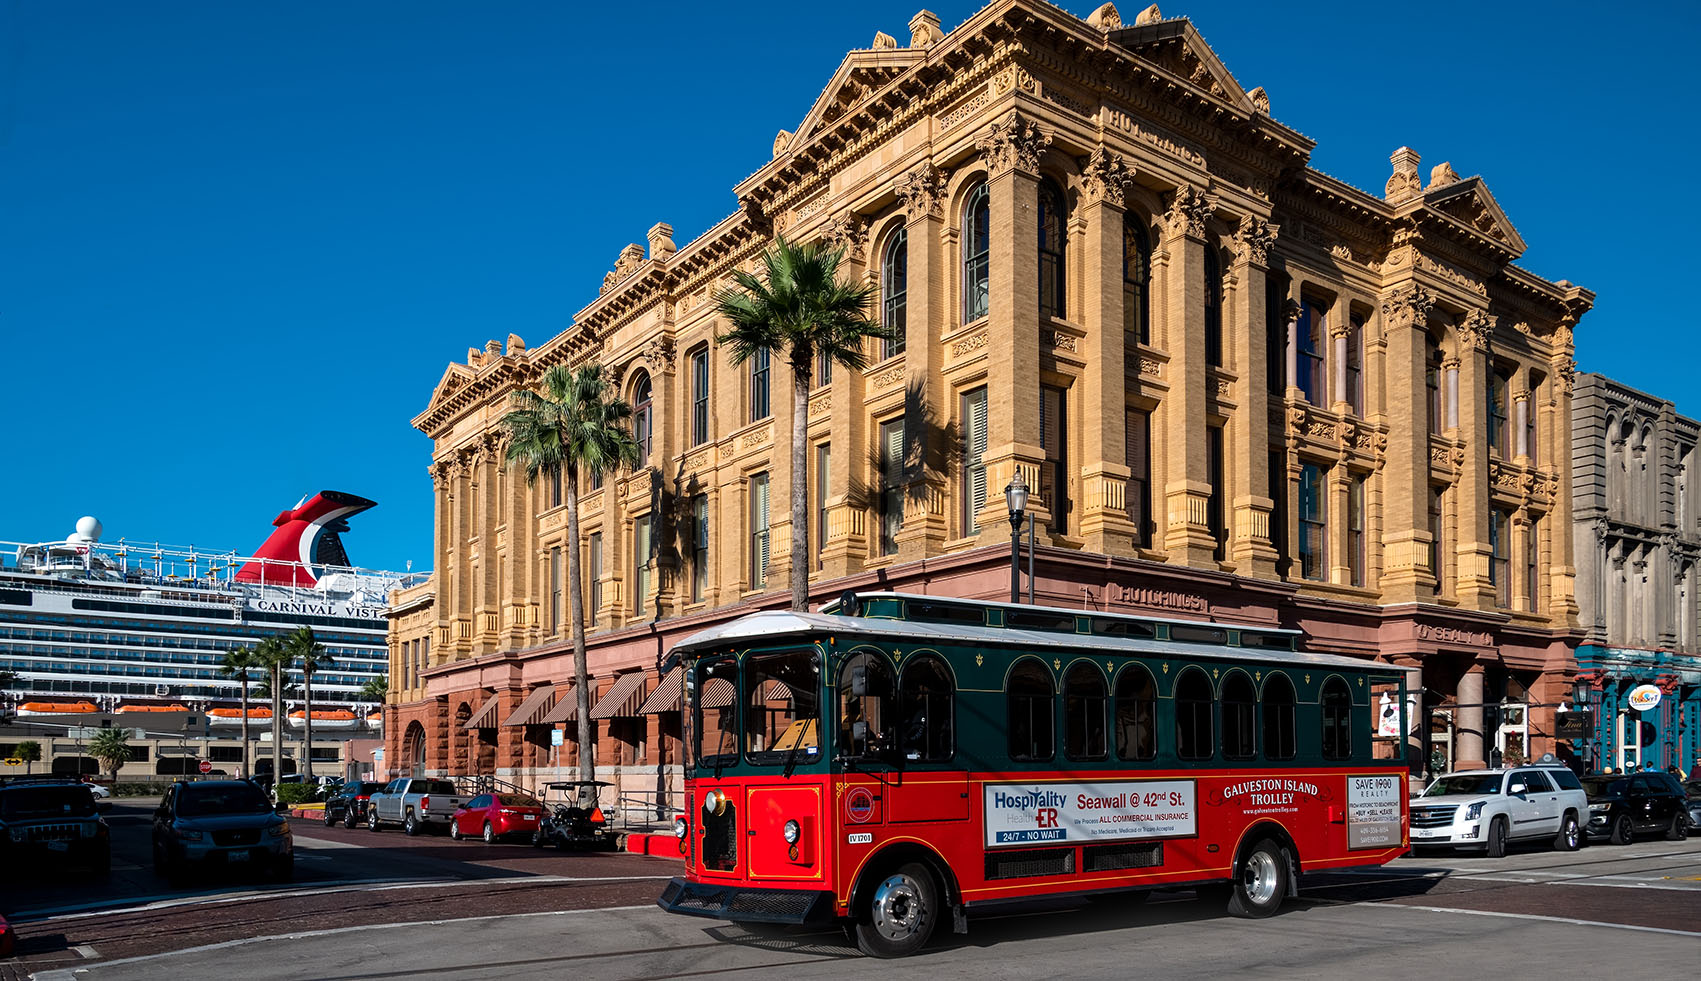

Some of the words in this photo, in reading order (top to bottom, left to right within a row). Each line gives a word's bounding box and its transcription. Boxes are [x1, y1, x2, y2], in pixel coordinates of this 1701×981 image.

[1119, 586, 1201, 609] HUTCHINGS
[257, 600, 337, 616] CARNIVAL
[346, 607, 384, 619] VIST
[1435, 626, 1473, 643] SEALY
[1223, 779, 1282, 799] GALVESTON
[1284, 779, 1318, 796] ISLAND
[1355, 779, 1373, 789] SAVE
[995, 790, 1067, 811] Hospitality
[1077, 793, 1127, 809] Seawall
[1130, 792, 1140, 808] @
[1143, 792, 1167, 807] 42nd
[1169, 791, 1185, 807] St.
[1250, 793, 1294, 805] TROLLEY
[1360, 790, 1389, 798] REALTY
[1006, 812, 1034, 824] Health
[1035, 808, 1059, 828] ER
[1099, 816, 1112, 824] ALL
[1112, 814, 1154, 823] COMMERCIAL
[1154, 812, 1189, 821] INSURANCE
[1243, 806, 1299, 815] www.galvestontrolley.com
[1003, 832, 1020, 842] 24/7
[1027, 831, 1039, 840] NO
[1041, 830, 1060, 840] WAIT
